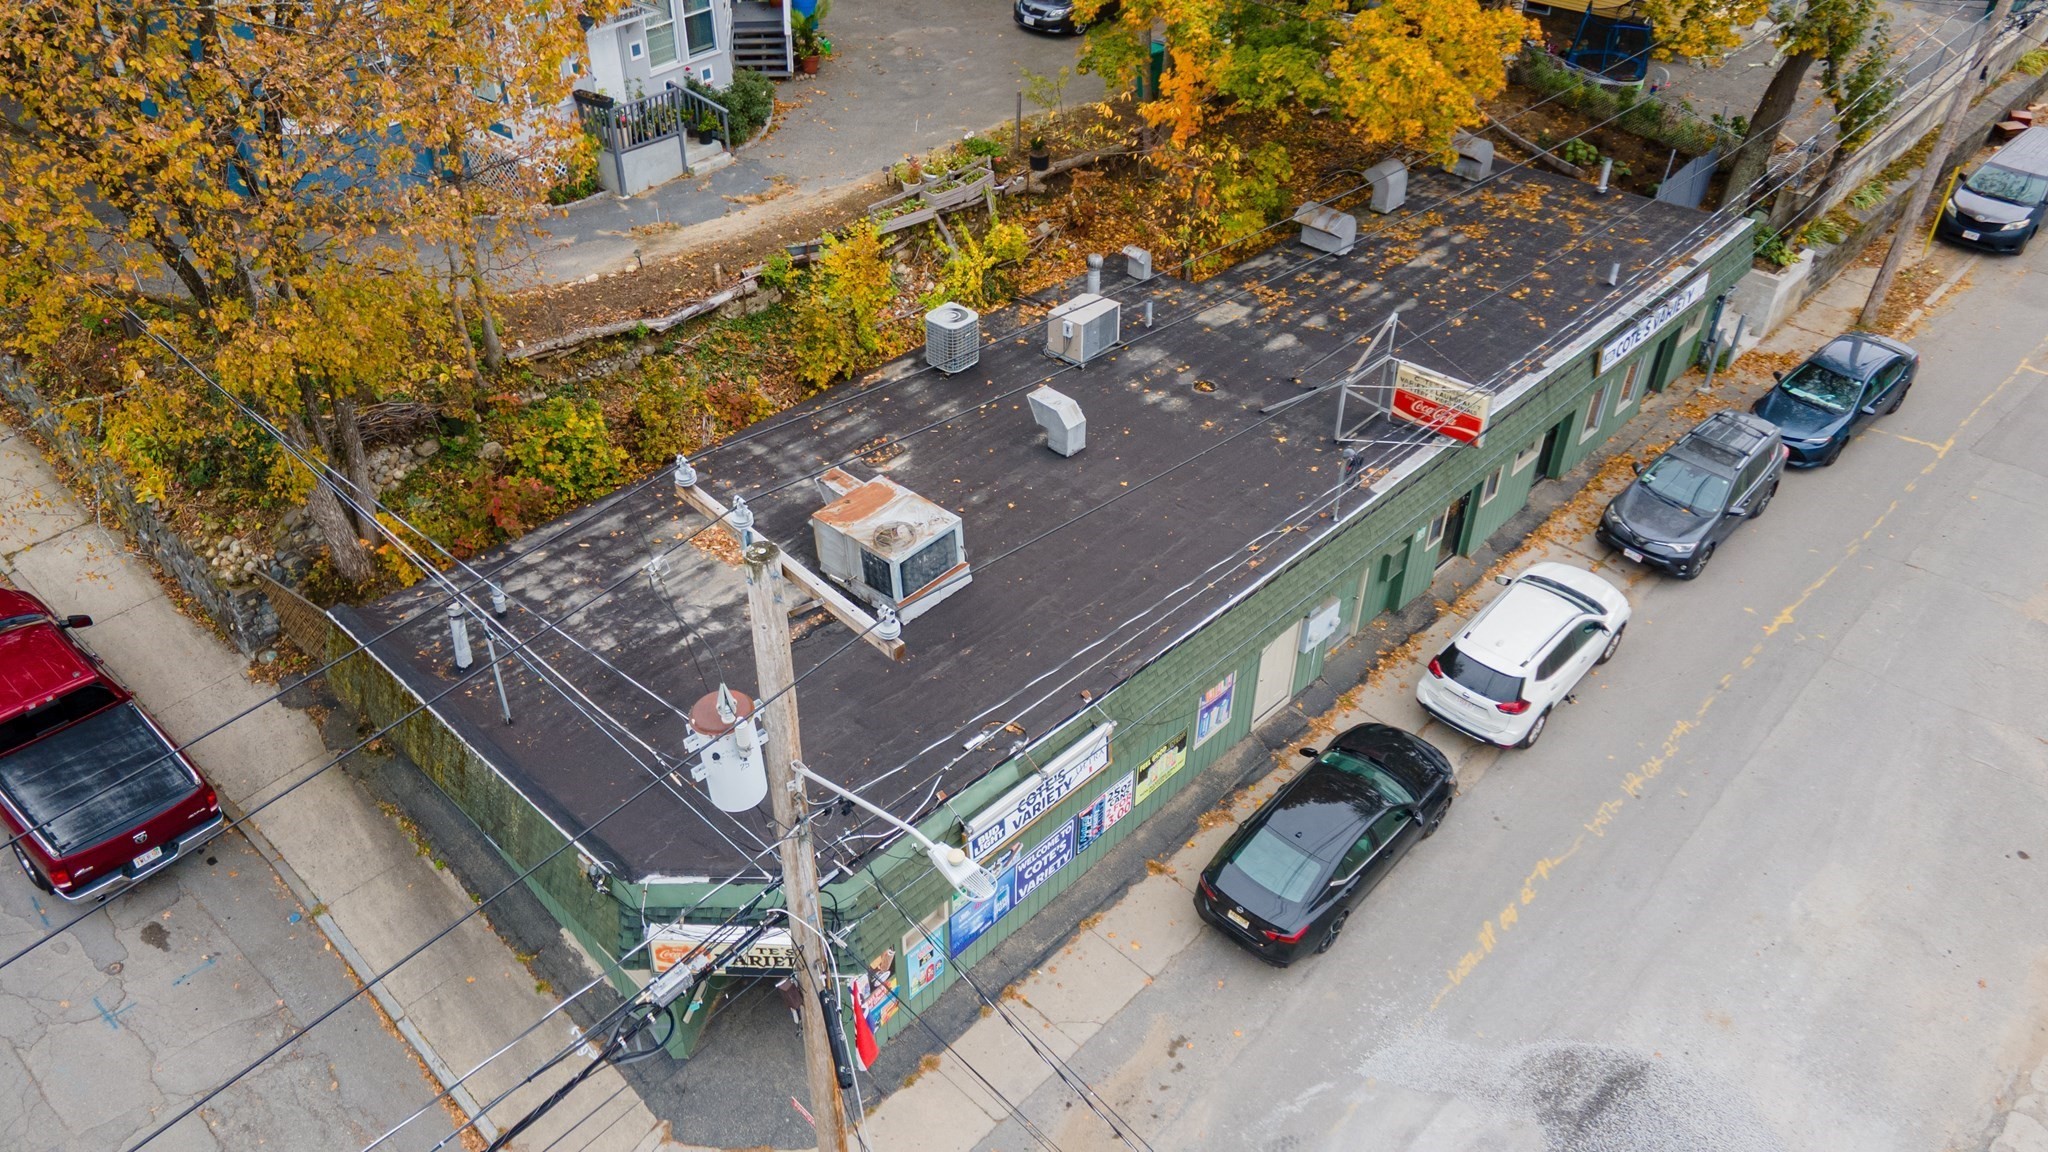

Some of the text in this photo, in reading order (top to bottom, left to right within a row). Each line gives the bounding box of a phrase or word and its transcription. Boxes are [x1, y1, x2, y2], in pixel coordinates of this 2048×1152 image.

[1616, 320, 1652, 357] COTES
[1012, 777, 1072, 829] VARIETY
[1017, 769, 1066, 813] COTE'S
[974, 829, 1005, 857] LIGHT
[978, 824, 1001, 847] BUD
[1018, 835, 1060, 872] WELCOME
[1061, 825, 1072, 838] TO
[1018, 849, 1071, 898] VARIETY
[1024, 839, 1067, 879] COTE'S
[731, 954, 795, 968] ARIET
